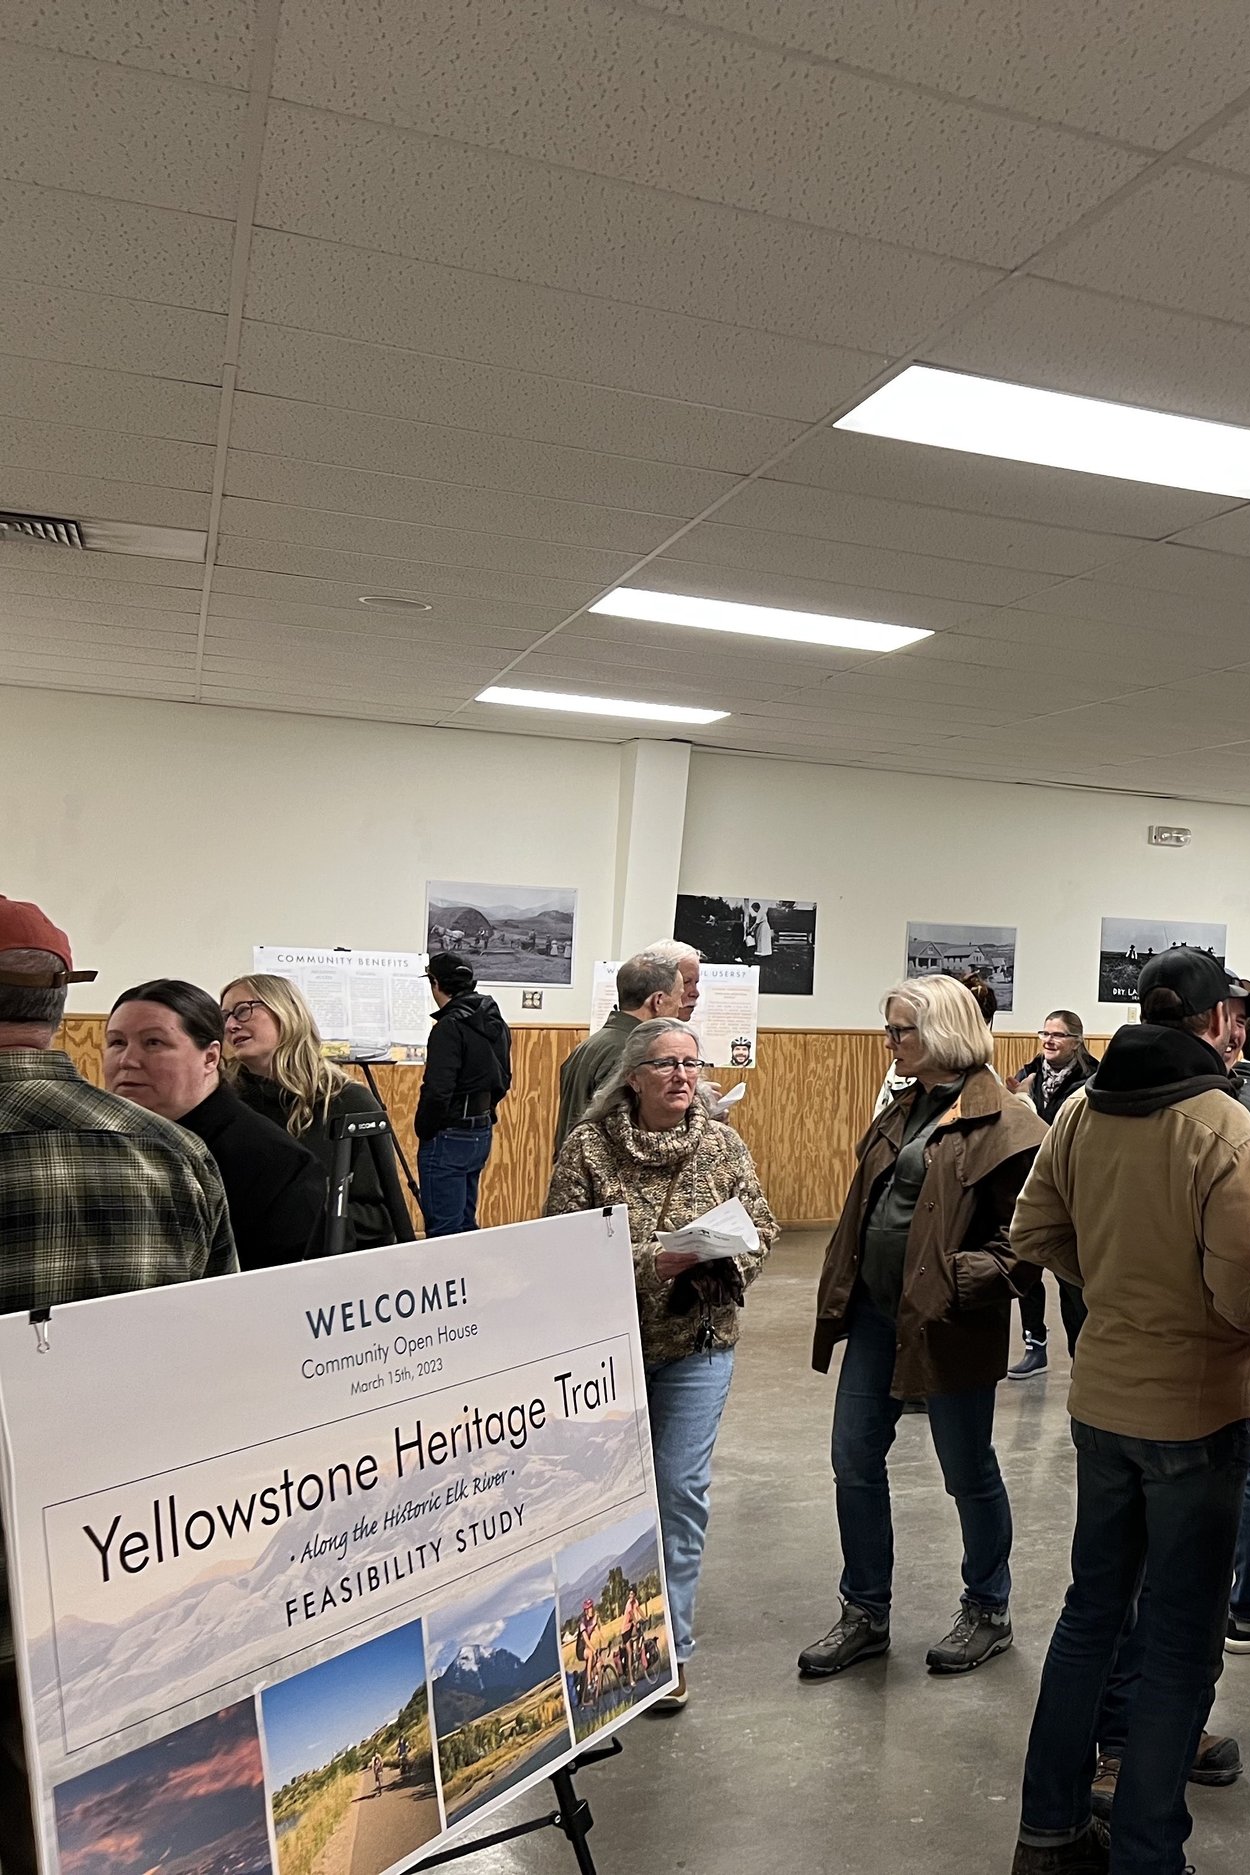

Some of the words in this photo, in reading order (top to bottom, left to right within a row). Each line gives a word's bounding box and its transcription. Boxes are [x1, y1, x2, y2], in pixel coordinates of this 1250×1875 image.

[277, 954, 353, 965] COMMUNITY
[358, 957, 410, 968] BENEFITS
[711, 969, 746, 978] USERS?
[305, 1277, 468, 1339] WELCOME!
[301, 1342, 389, 1379] Community
[394, 1333, 433, 1356] Open
[437, 1323, 478, 1344] House
[350, 1374, 385, 1395] March
[388, 1366, 415, 1385] 15th,
[416, 1357, 443, 1377] 2023
[82, 1454, 378, 1582] Yellowstone
[394, 1398, 546, 1478] Heritage
[553, 1356, 616, 1418] Trail
[300, 1531, 348, 1563] Along
[352, 1514, 379, 1543] the
[383, 1491, 441, 1531] Historic
[445, 1480, 469, 1507] Elk
[472, 1469, 508, 1496] River
[285, 1537, 443, 1627] FEASIBILITY
[455, 1503, 526, 1553] STUDY
